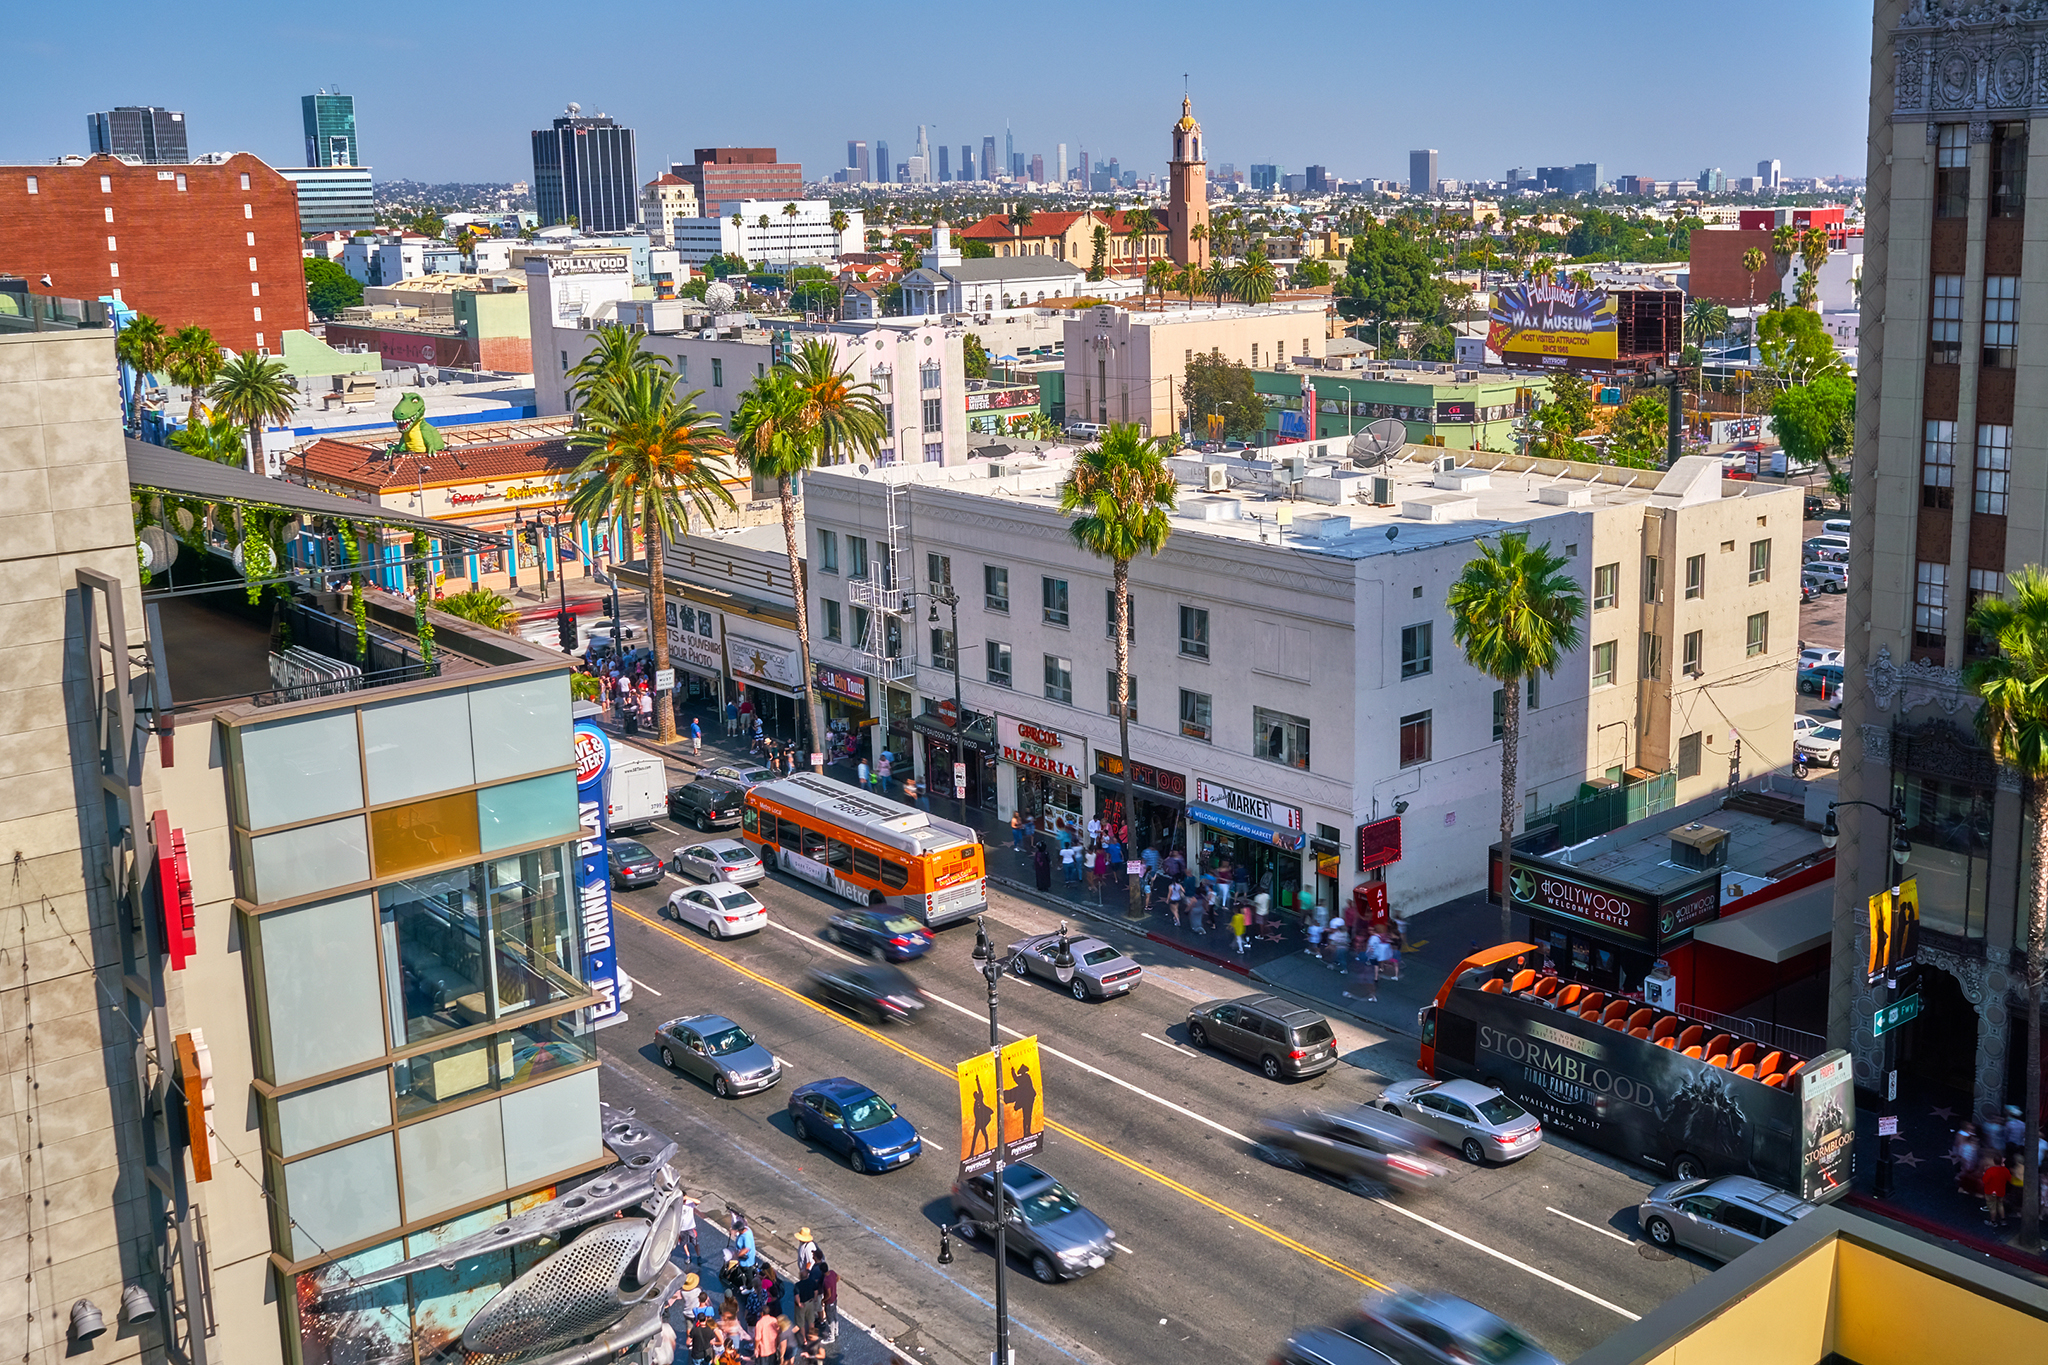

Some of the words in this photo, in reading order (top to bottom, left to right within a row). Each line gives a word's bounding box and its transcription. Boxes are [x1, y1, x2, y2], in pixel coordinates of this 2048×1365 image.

[553, 257, 625, 270] HOLLYWOOD
[1525, 273, 1579, 317] Hollywood
[1512, 310, 1539, 328] WAX
[1542, 313, 1593, 332] MUSEUM
[1535, 335, 1555, 343] VISITED
[1556, 337, 1589, 345] ATTRACTION
[1543, 345, 1556, 353] SINCE
[969, 401, 990, 411] MUSIC
[506, 484, 549, 500] Believe
[668, 644, 687, 660] HOUR
[689, 647, 713, 668] PHOTO
[688, 635, 722, 656] SOUVENIRS
[591, 738, 602, 752] &
[914, 725, 946, 740] HARLEY-DAVIDSON
[952, 737, 978, 749] HOWOOD
[576, 750, 604, 776] STER'S
[1004, 746, 1079, 780] PIZZERIA
[760, 802, 771, 811] Metro
[772, 806, 782, 815] Local
[833, 803, 870, 818] 5690
[1227, 791, 1269, 820] MARKET
[577, 800, 602, 857] PLAY
[1194, 810, 1219, 823] WELCOME
[1219, 818, 1226, 826] TO
[1226, 820, 1251, 834] HIGHLAND
[1251, 828, 1272, 840] MARKET
[834, 879, 870, 908] Metro
[1377, 889, 1385, 919] ATM
[1541, 880, 1631, 918] HOLLYWOOD
[580, 878, 611, 953] DRINK
[1547, 897, 1589, 916] WELCOME
[1594, 910, 1629, 928] CENTER
[1675, 894, 1716, 920] HOLLYWOOD
[1678, 911, 1698, 923] WELCOME
[1698, 904, 1715, 917] CENTER
[591, 977, 617, 1021] EAT
[1559, 1032, 1575, 1042] NOW
[1577, 1039, 1586, 1047] AT
[1479, 1025, 1654, 1107] STORMBLOOD
[1524, 1067, 1547, 1088] FINAL
[1550, 1076, 1584, 1103] FANTASY
[1519, 1094, 1565, 1117] AVAILABLE
[1568, 1112, 1601, 1130] 6.20.17
[1804, 1130, 1855, 1166] STORMBLOOD
